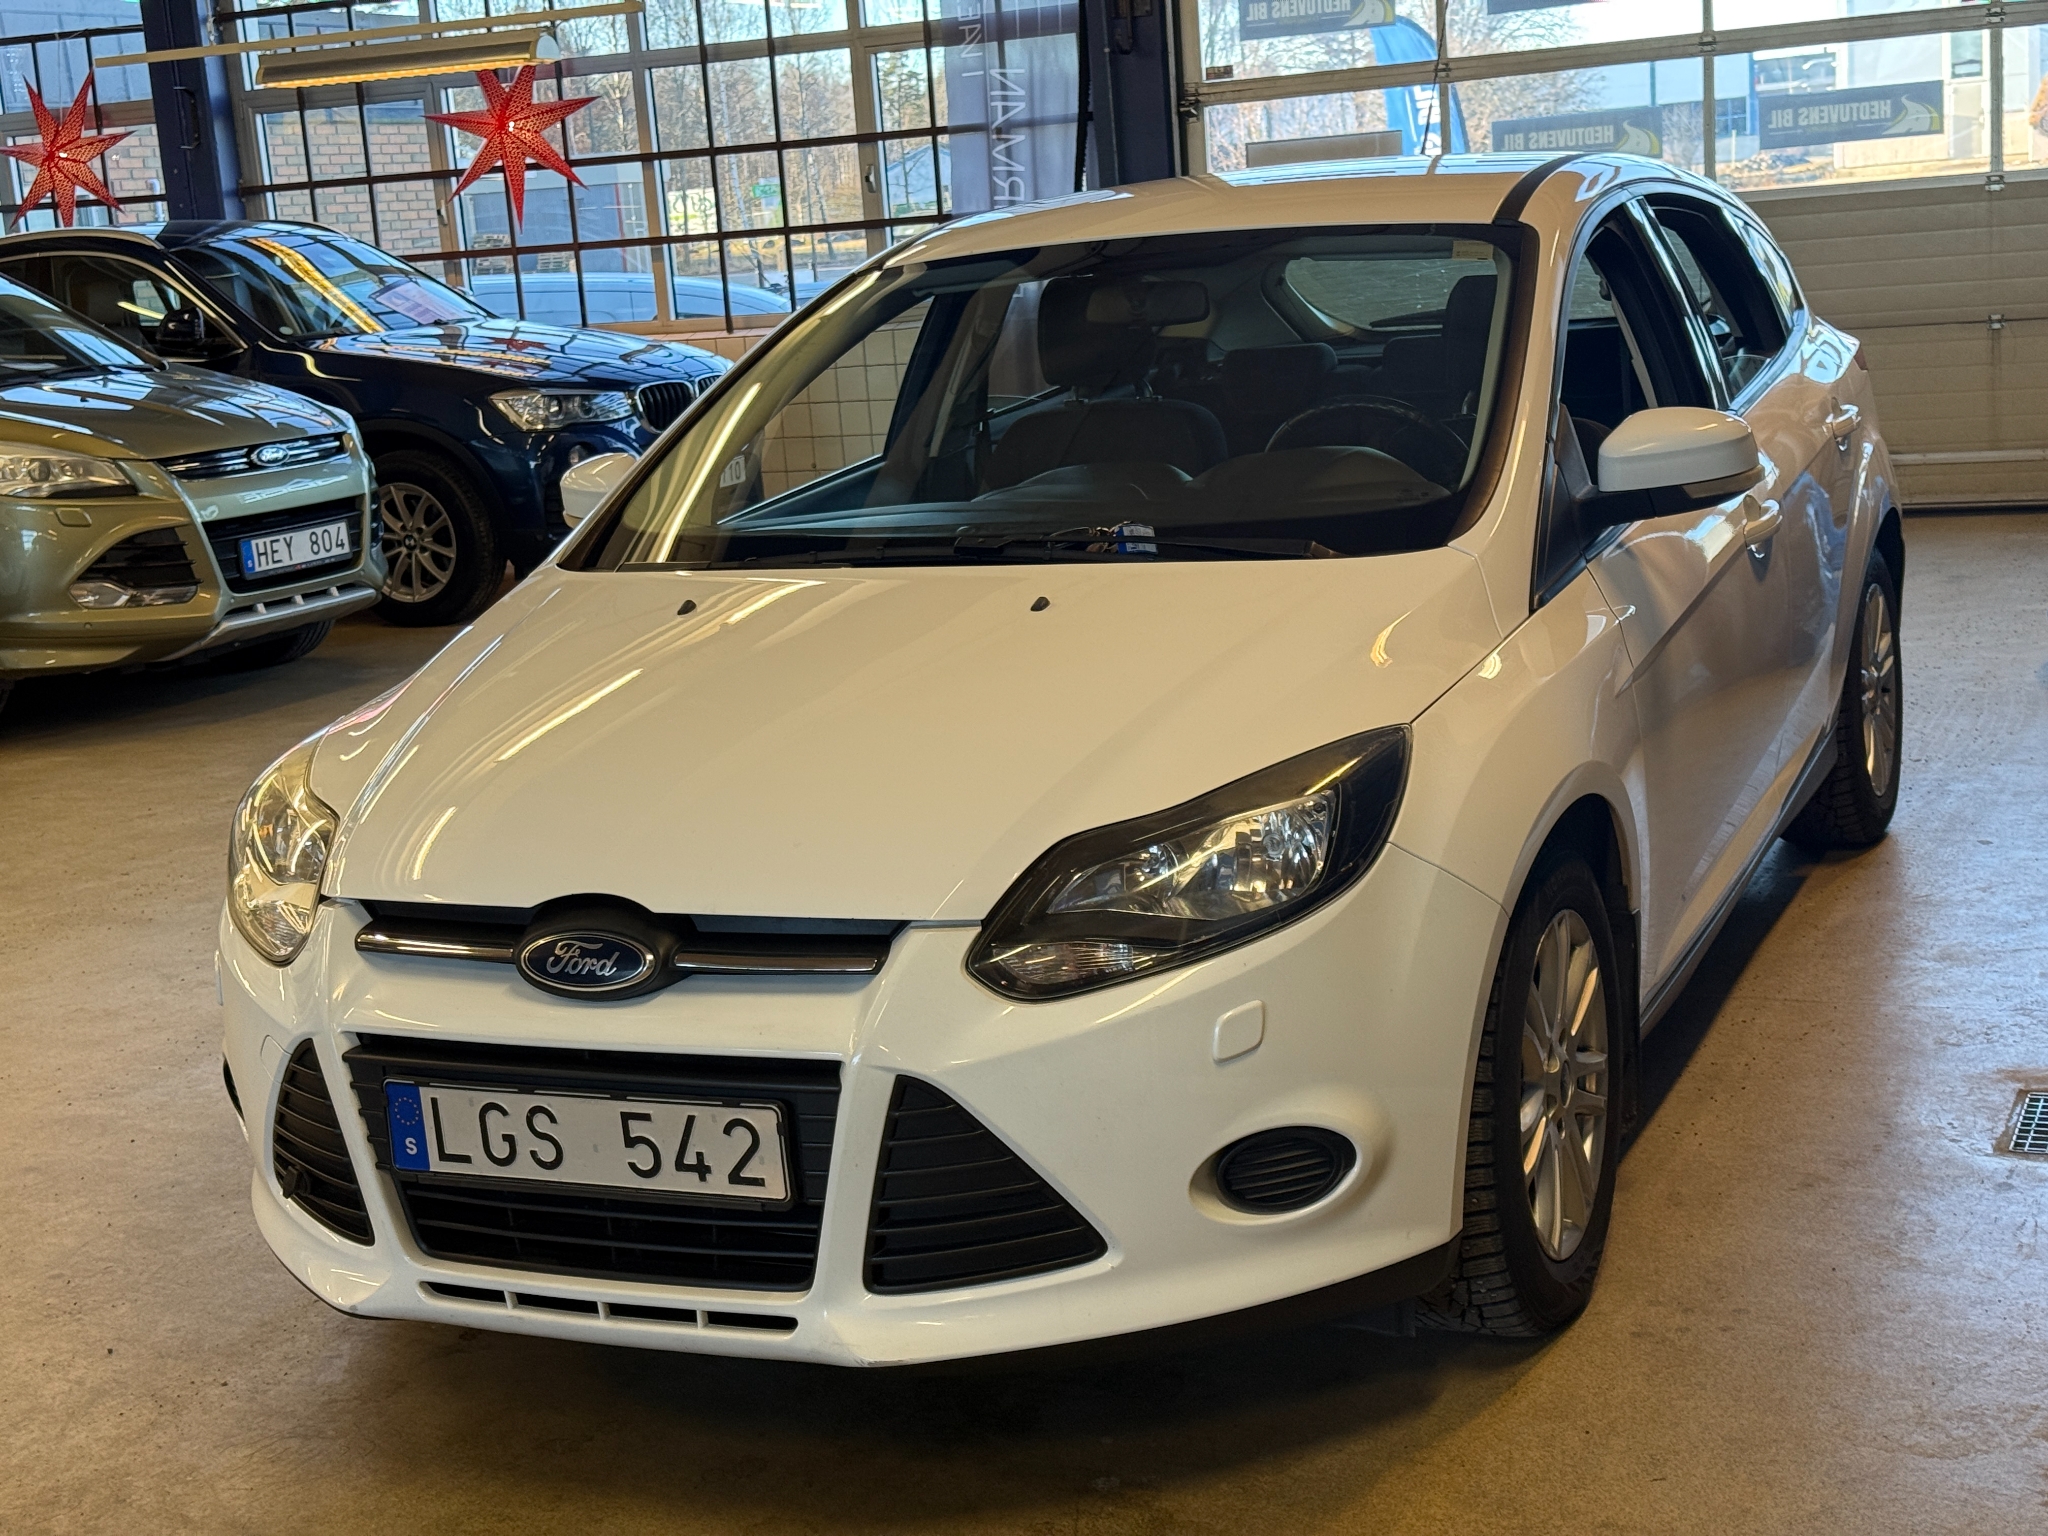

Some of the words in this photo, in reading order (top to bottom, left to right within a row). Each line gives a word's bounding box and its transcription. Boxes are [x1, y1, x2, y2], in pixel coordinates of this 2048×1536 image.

[255, 535, 294, 568] HEY
[309, 526, 345, 556] 804
[546, 940, 621, 977] Ford
[405, 1137, 418, 1156] S
[430, 1096, 564, 1171] LGS
[619, 1110, 767, 1188] 542
